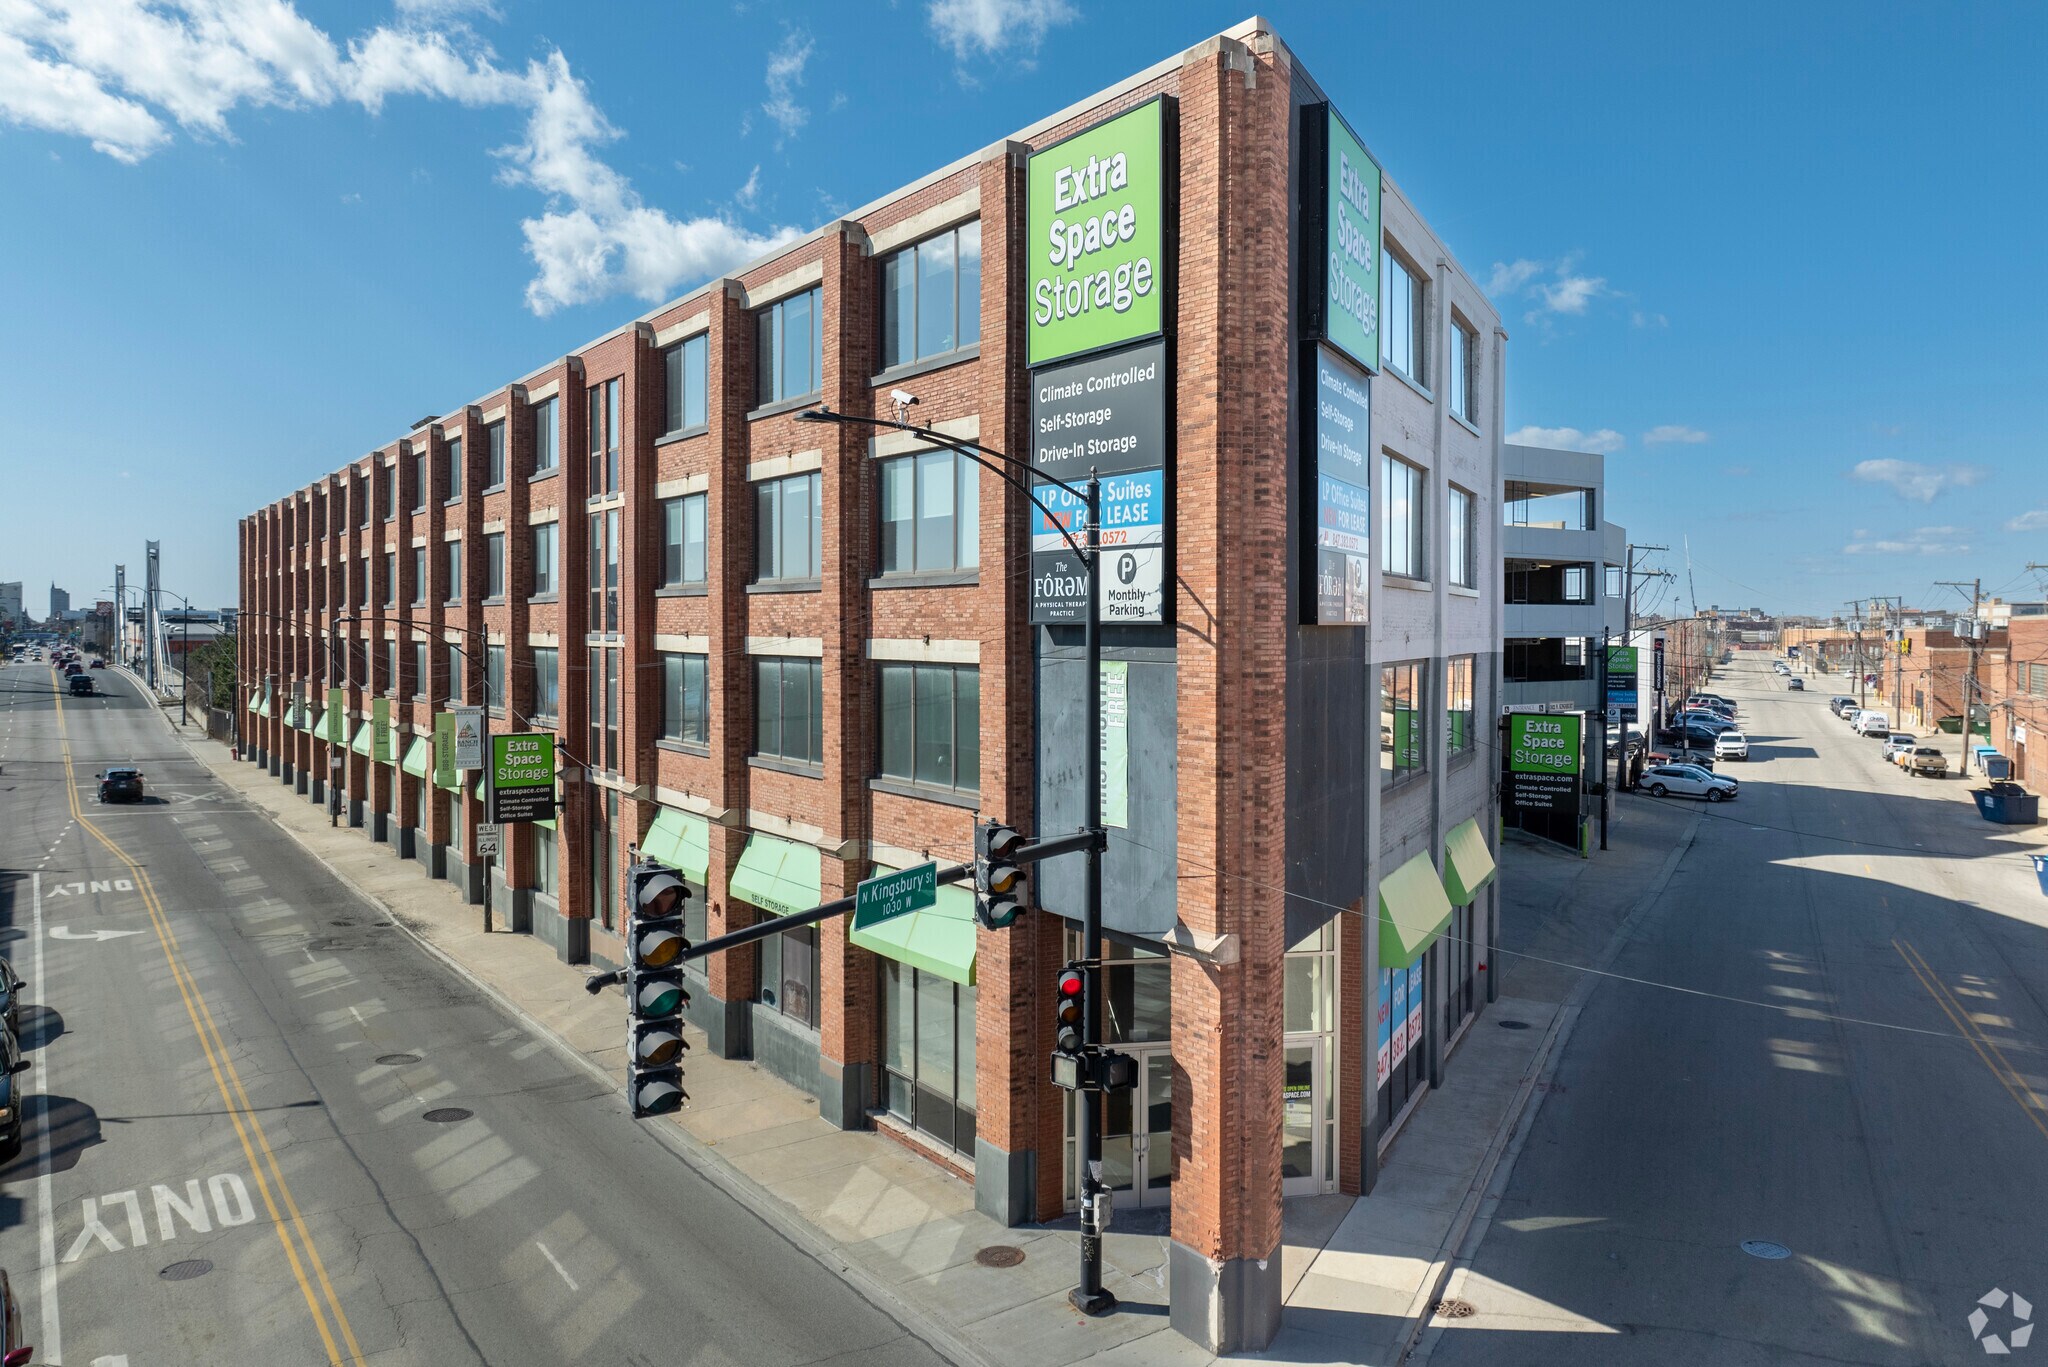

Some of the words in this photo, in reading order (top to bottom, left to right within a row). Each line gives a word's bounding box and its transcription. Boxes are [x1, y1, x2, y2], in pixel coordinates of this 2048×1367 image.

[1055, 151, 1127, 213] Extra
[1340, 150, 1369, 221] Extra
[1049, 204, 1136, 271] Space
[1337, 201, 1371, 272] Space
[1035, 257, 1153, 326] Storage
[1330, 251, 1376, 336] Storage
[1040, 382, 1083, 403] Climate
[1087, 363, 1155, 393] Controlled
[1321, 369, 1342, 394] Climate
[1343, 382, 1368, 410] Controlled
[1040, 407, 1112, 433] Self-Storage
[1321, 401, 1354, 432] Self-Storage
[1040, 442, 1084, 463] Drive-In
[1088, 435, 1137, 455] Storage
[1321, 433, 1343, 457] Drive-In
[1343, 443, 1362, 466] Storage
[1041, 490, 1056, 509] LP
[1107, 480, 1151, 502] Suites
[1107, 502, 1149, 524] LEASE
[1062, 530, 1127, 548] 87.3.0572
[1056, 561, 1068, 573] The
[1108, 588, 1145, 602] Monthly
[1109, 604, 1145, 617] Parking
[1107, 671, 1125, 728] FREE
[1526, 720, 1561, 733] Extra
[507, 740, 539, 752] Extra
[1523, 734, 1565, 750] Space
[505, 753, 542, 767] Space
[1515, 749, 1572, 767] Storage
[498, 768, 549, 780] Storage
[1515, 773, 1573, 782] extraspace.com
[499, 787, 550, 796] extraspace.com
[1515, 792, 1552, 800] Self-Storage
[1539, 785, 1572, 793] Controlled
[480, 843, 496, 853] 64
[46, 879, 134, 898] ONLY
[862, 892, 868, 904] N
[871, 874, 924, 902] Kingsbury
[926, 872, 932, 884] St
[751, 893, 763, 904] SELF
[765, 898, 789, 915] STORAGE
[882, 900, 902, 916] 1030
[905, 896, 912, 908] W
[1394, 983, 1405, 1009] FOR
[1283, 1091, 1311, 1099] ASPACE.COM
[61, 1173, 256, 1263] ONLY
